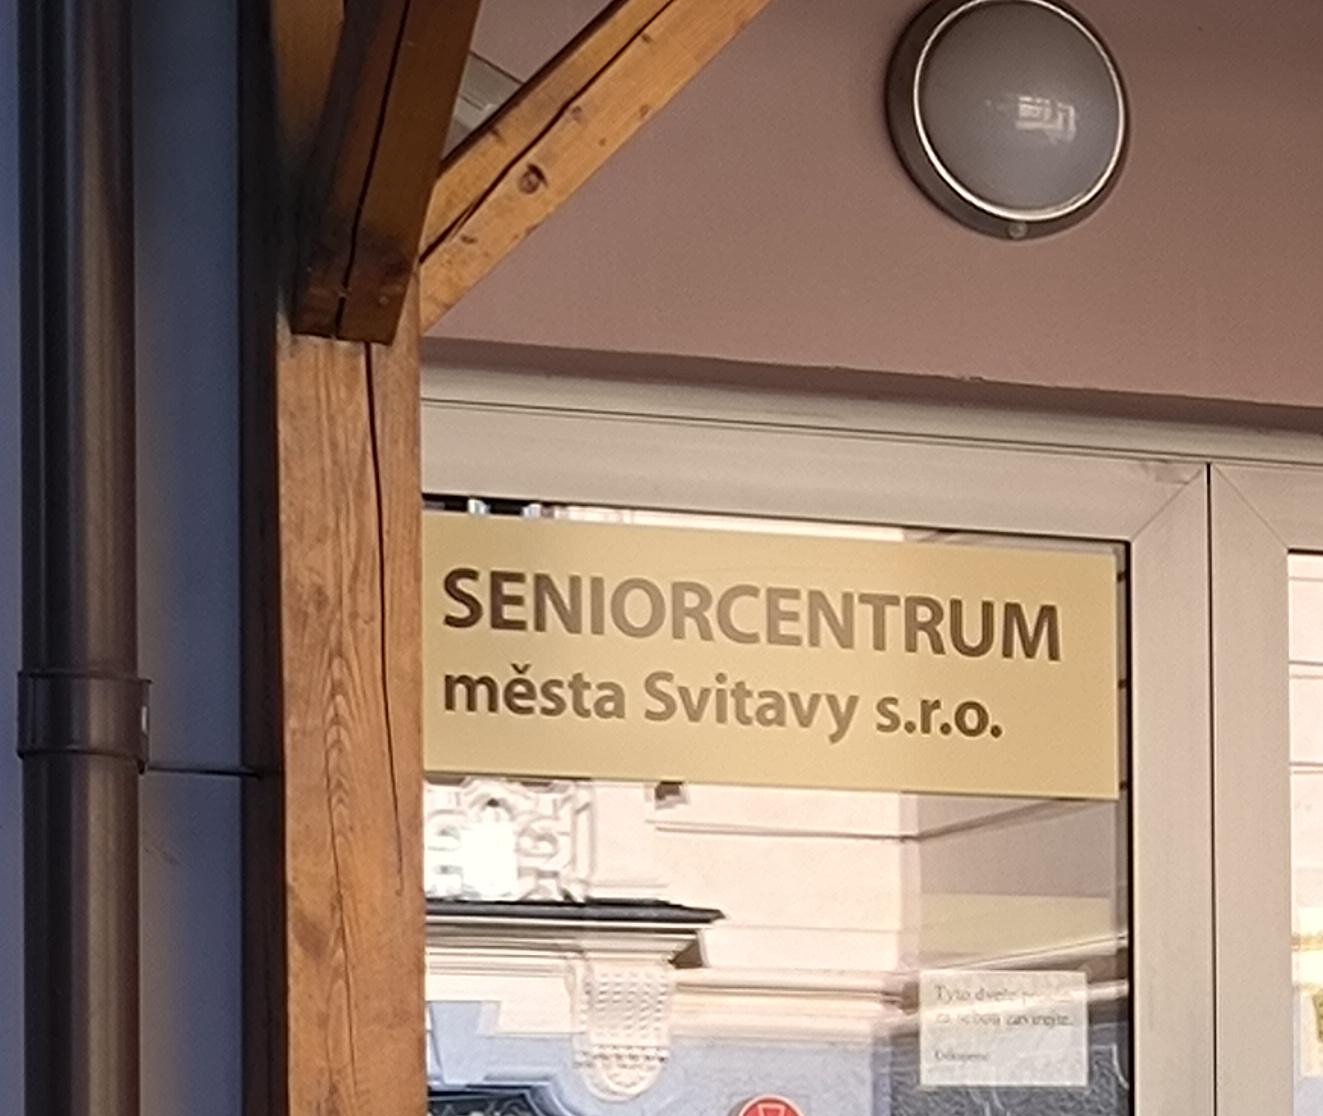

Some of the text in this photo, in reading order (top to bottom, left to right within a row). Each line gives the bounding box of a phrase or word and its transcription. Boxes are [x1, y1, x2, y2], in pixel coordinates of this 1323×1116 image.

[442, 567, 1061, 661] SENIORCENTRUM
[443, 662, 1003, 744] města Svitavy s.r.o.
